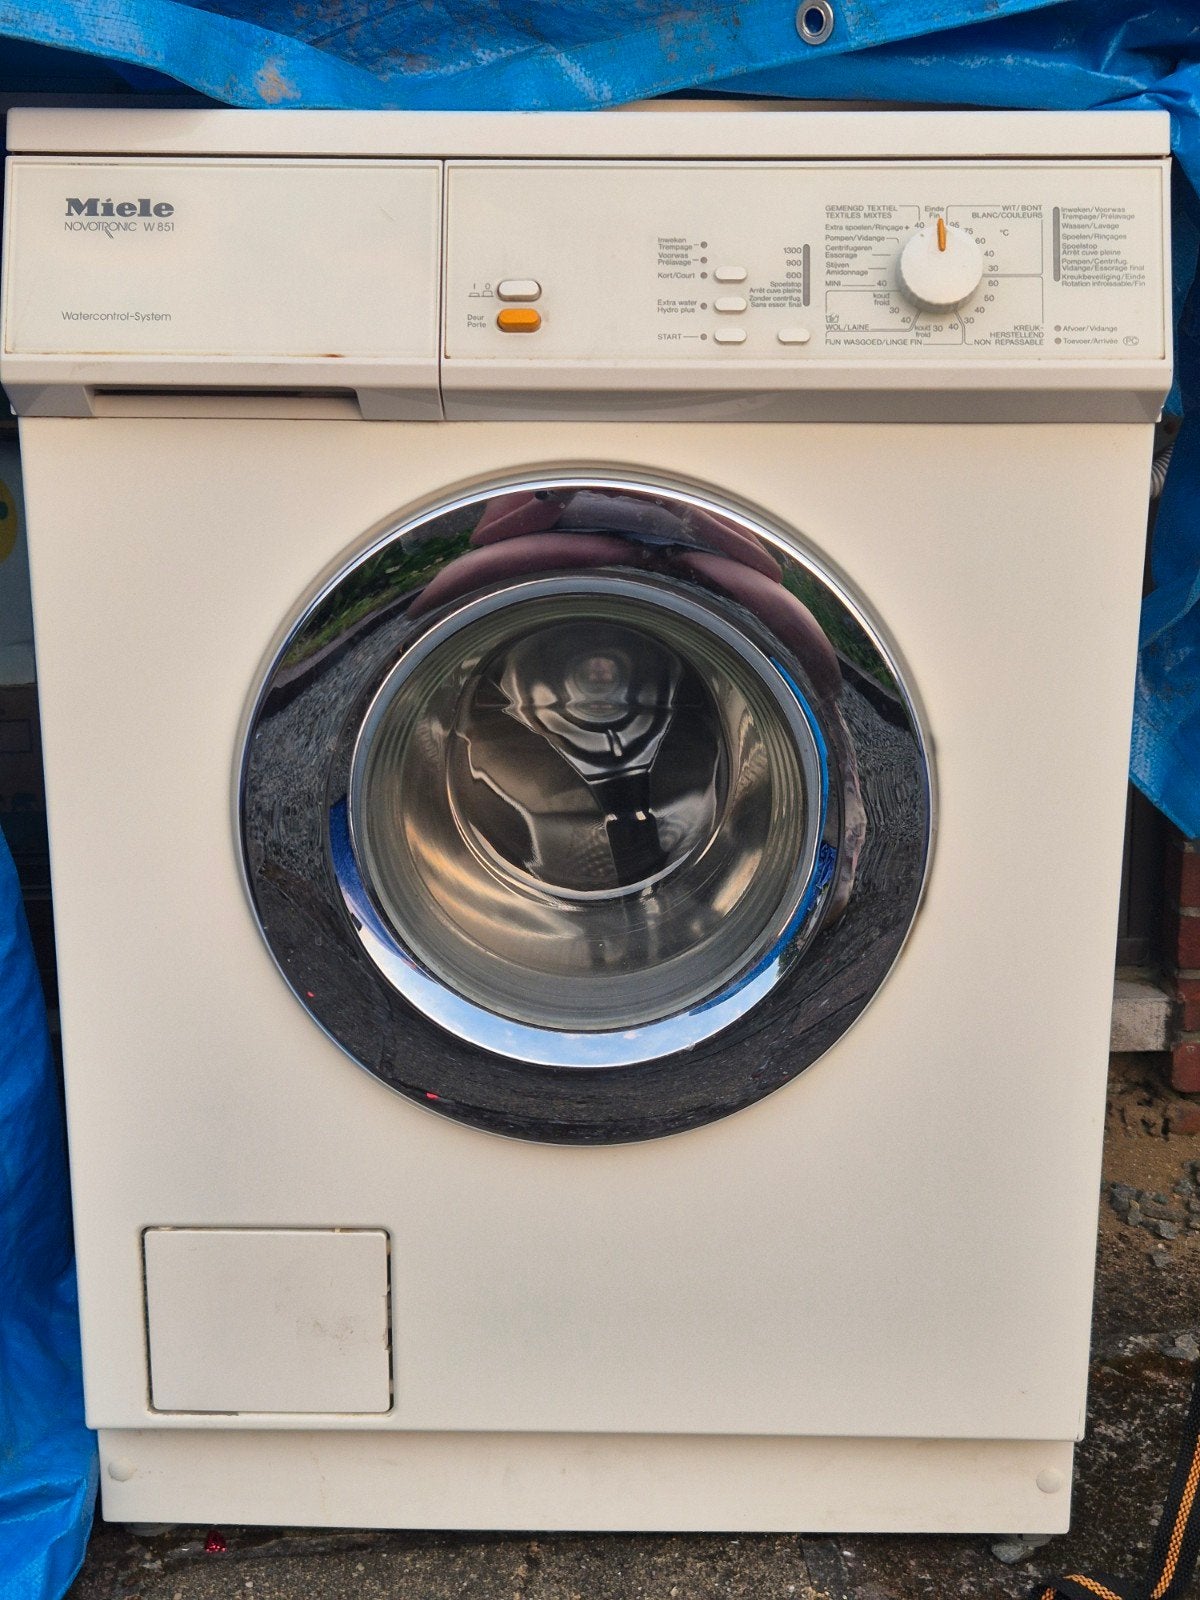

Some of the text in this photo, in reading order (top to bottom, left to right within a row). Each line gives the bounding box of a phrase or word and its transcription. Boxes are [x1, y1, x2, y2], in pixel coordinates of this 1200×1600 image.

[65, 197, 175, 218] Miele
[64, 221, 174, 239] NOVOTRONIC W 851
[824, 234, 886, 243] Pompen/Vidange
[824, 252, 858, 260] Essorage
[658, 258, 692, 266] Prélavage
[825, 261, 850, 269] Stijven
[984, 294, 995, 302] 50
[61, 311, 172, 323] Watercontrol-System
